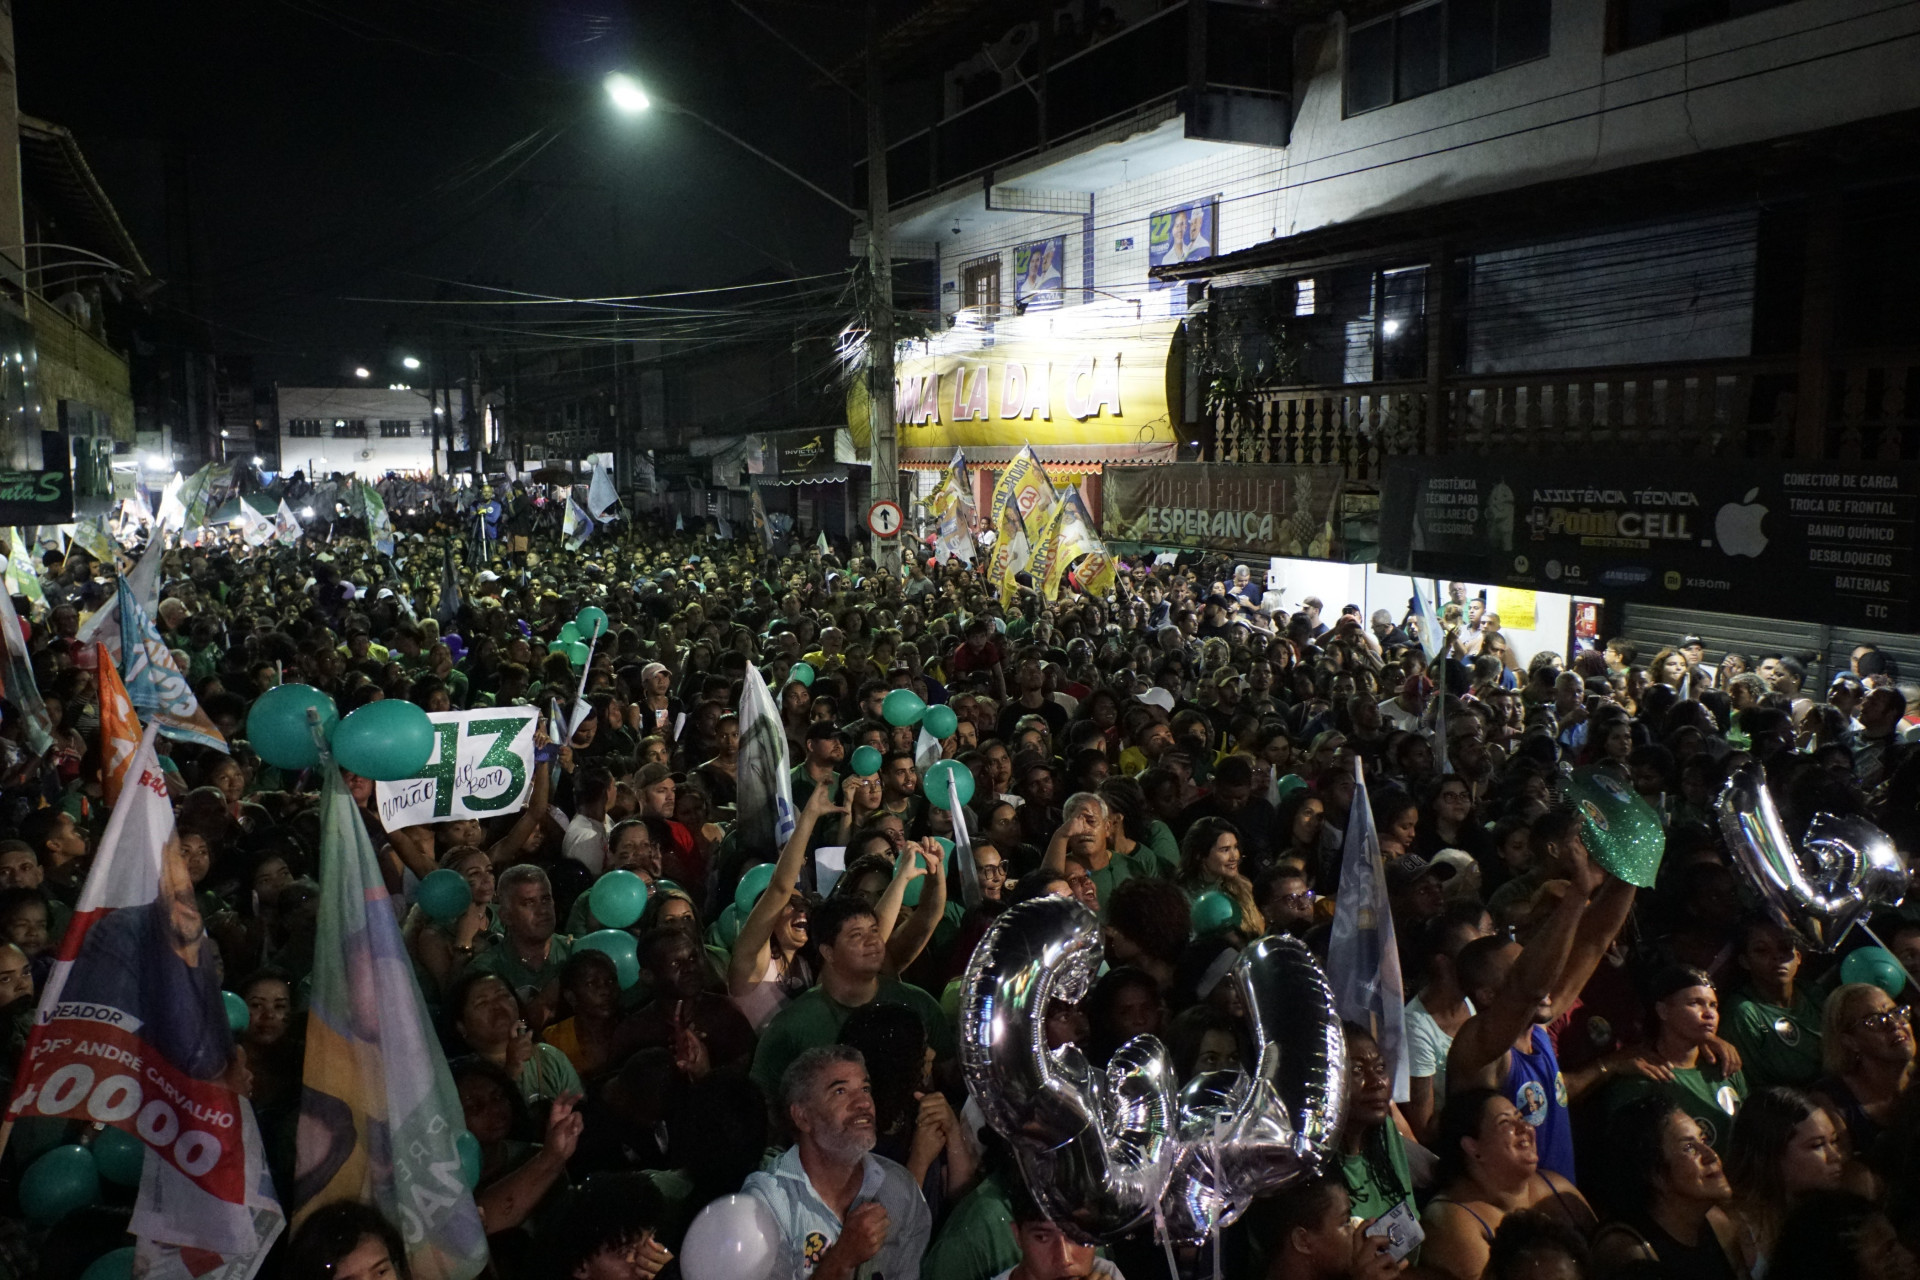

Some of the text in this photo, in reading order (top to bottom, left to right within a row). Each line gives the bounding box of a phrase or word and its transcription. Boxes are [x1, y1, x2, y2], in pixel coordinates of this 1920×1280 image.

[1151, 213, 1171, 244] 22
[1016, 250, 1031, 274] 22
[895, 372, 941, 424] MA
[952, 366, 989, 421] LA
[1000, 361, 1051, 420] DA
[1428, 477, 1477, 490] ASSISTÊNCIA
[1783, 473, 1898, 489] CONECTOR DE CARGA
[1425, 491, 1478, 505] TÉCNICA PARA
[1533, 486, 1699, 506] ASSISTÊNCIA TÉCNICA
[1424, 508, 1467, 519] CELULARES
[1789, 498, 1896, 515] TROCA DE FRONTAL
[1149, 508, 1273, 544] ESPERANÇA
[1807, 523, 1895, 541] BANHO QUÍMICO
[1809, 549, 1892, 568] DESBLOQUEIOS
[1564, 565, 1580, 577] LG
[1604, 570, 1647, 582] SAMSUNG
[1686, 576, 1731, 591] xiaomi
[1835, 575, 1890, 592] BATERIAS
[1865, 603, 1888, 618] ETC
[455, 755, 474, 790] do
[43, 1003, 123, 1024] VREADOR
[74, 1039, 144, 1072] ANDRÉ
[146, 1067, 234, 1129] CARVALHO
